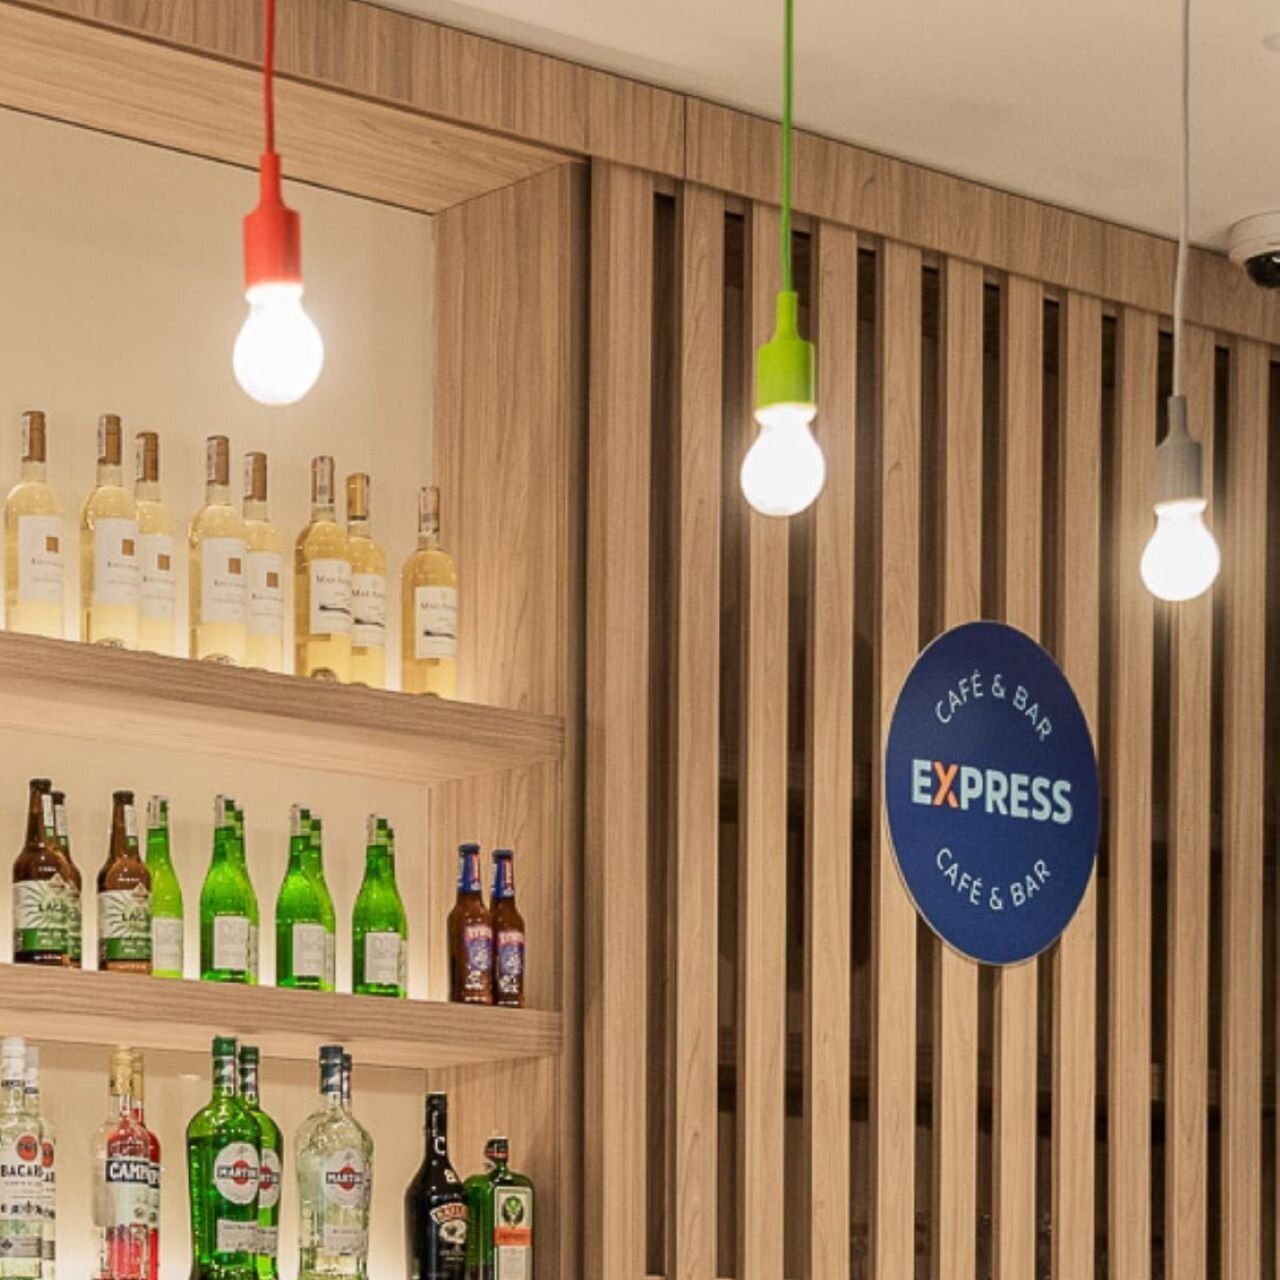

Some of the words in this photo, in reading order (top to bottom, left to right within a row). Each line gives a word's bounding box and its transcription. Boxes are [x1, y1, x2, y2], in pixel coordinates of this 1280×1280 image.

[934, 669, 984, 724] CAFÉ
[991, 673, 1006, 699] &
[1011, 685, 1053, 742] BAR
[911, 758, 1074, 825] EXPRESS
[935, 847, 983, 906] CAFÉ
[989, 886, 1004, 911] &
[1010, 859, 1052, 907] BAR
